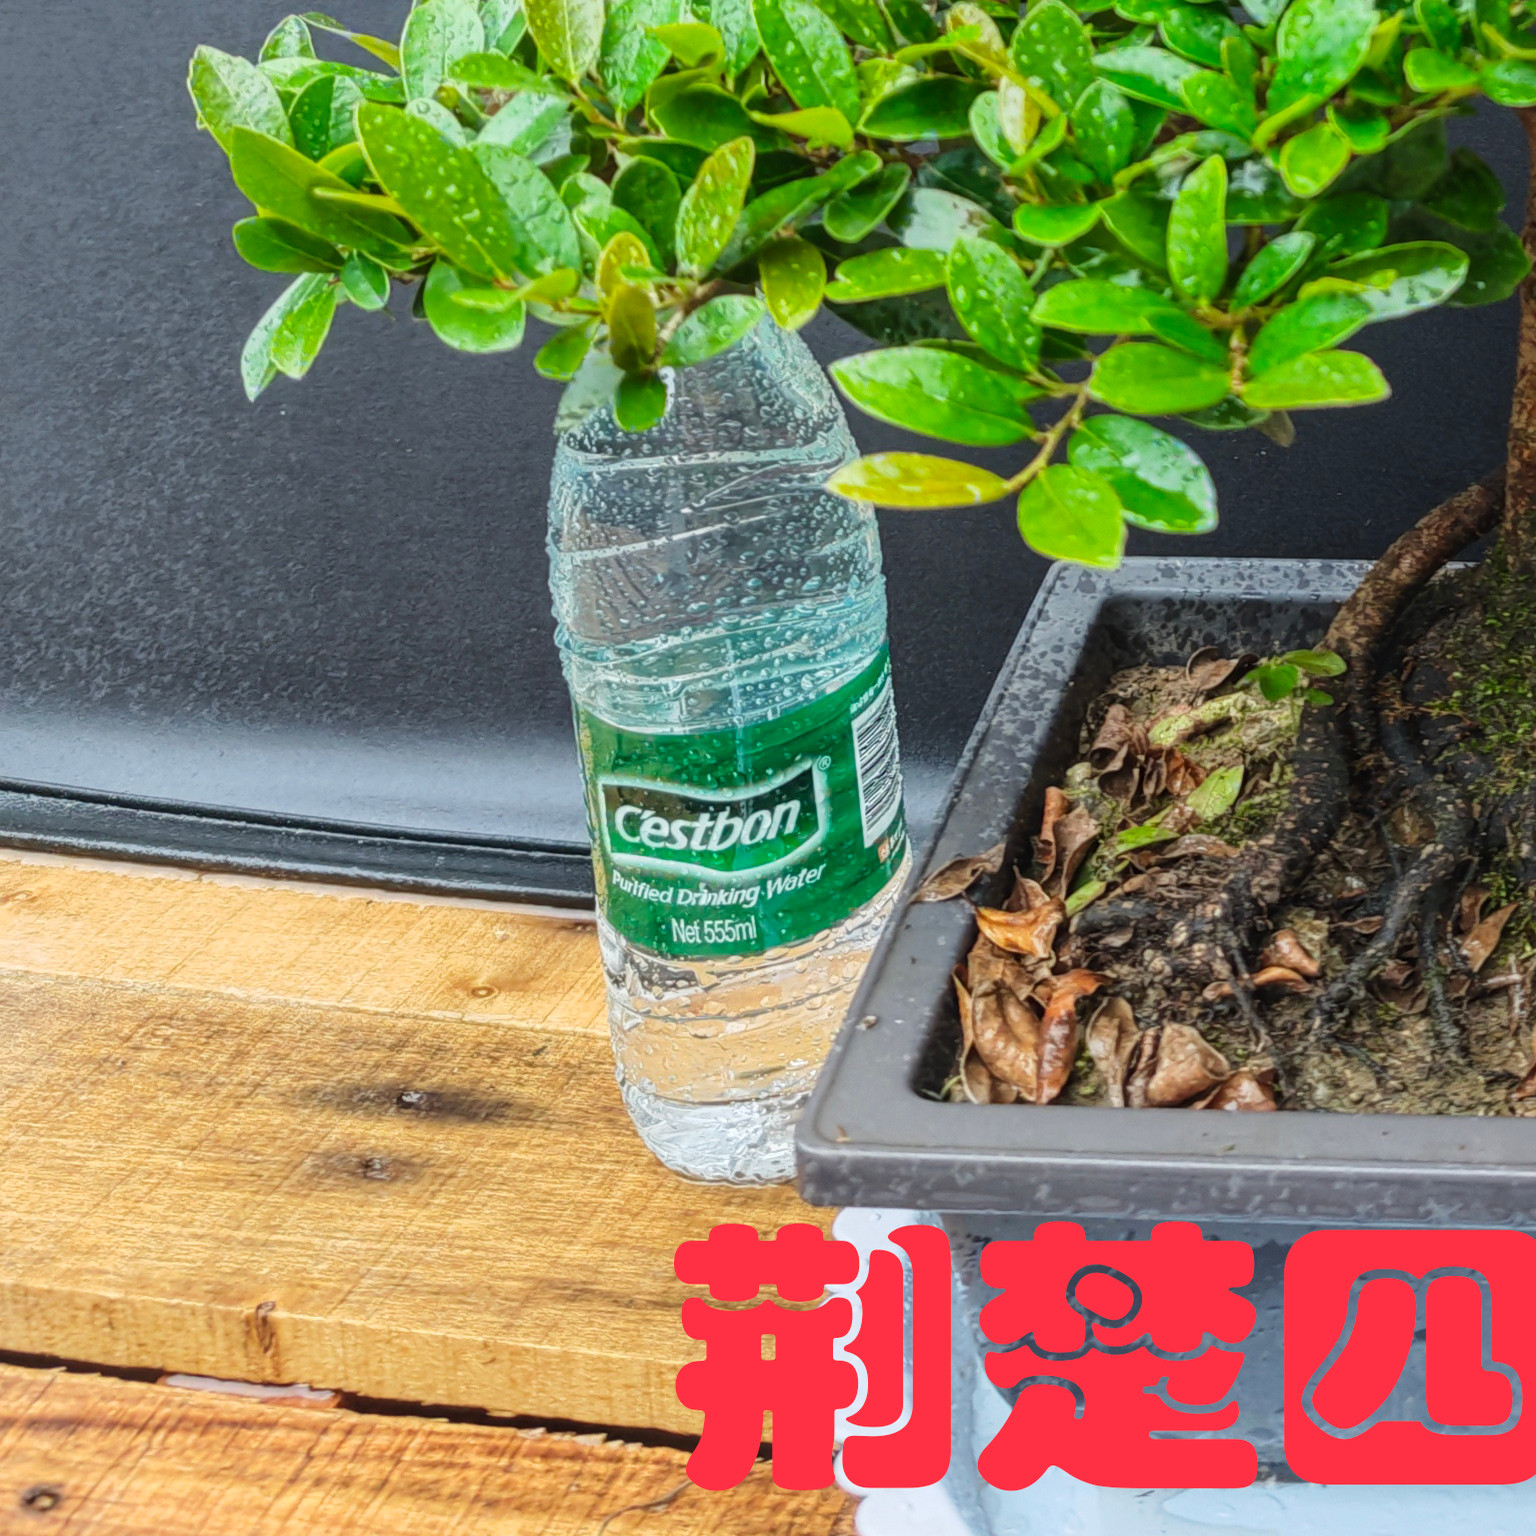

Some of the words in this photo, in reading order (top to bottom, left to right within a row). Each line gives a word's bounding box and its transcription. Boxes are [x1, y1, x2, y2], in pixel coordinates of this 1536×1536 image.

[611, 869, 672, 904] Purified
[676, 883, 760, 908] Drinking
[765, 864, 826, 899] Water
[671, 917, 702, 944] Net
[703, 915, 757, 943] 555ml
